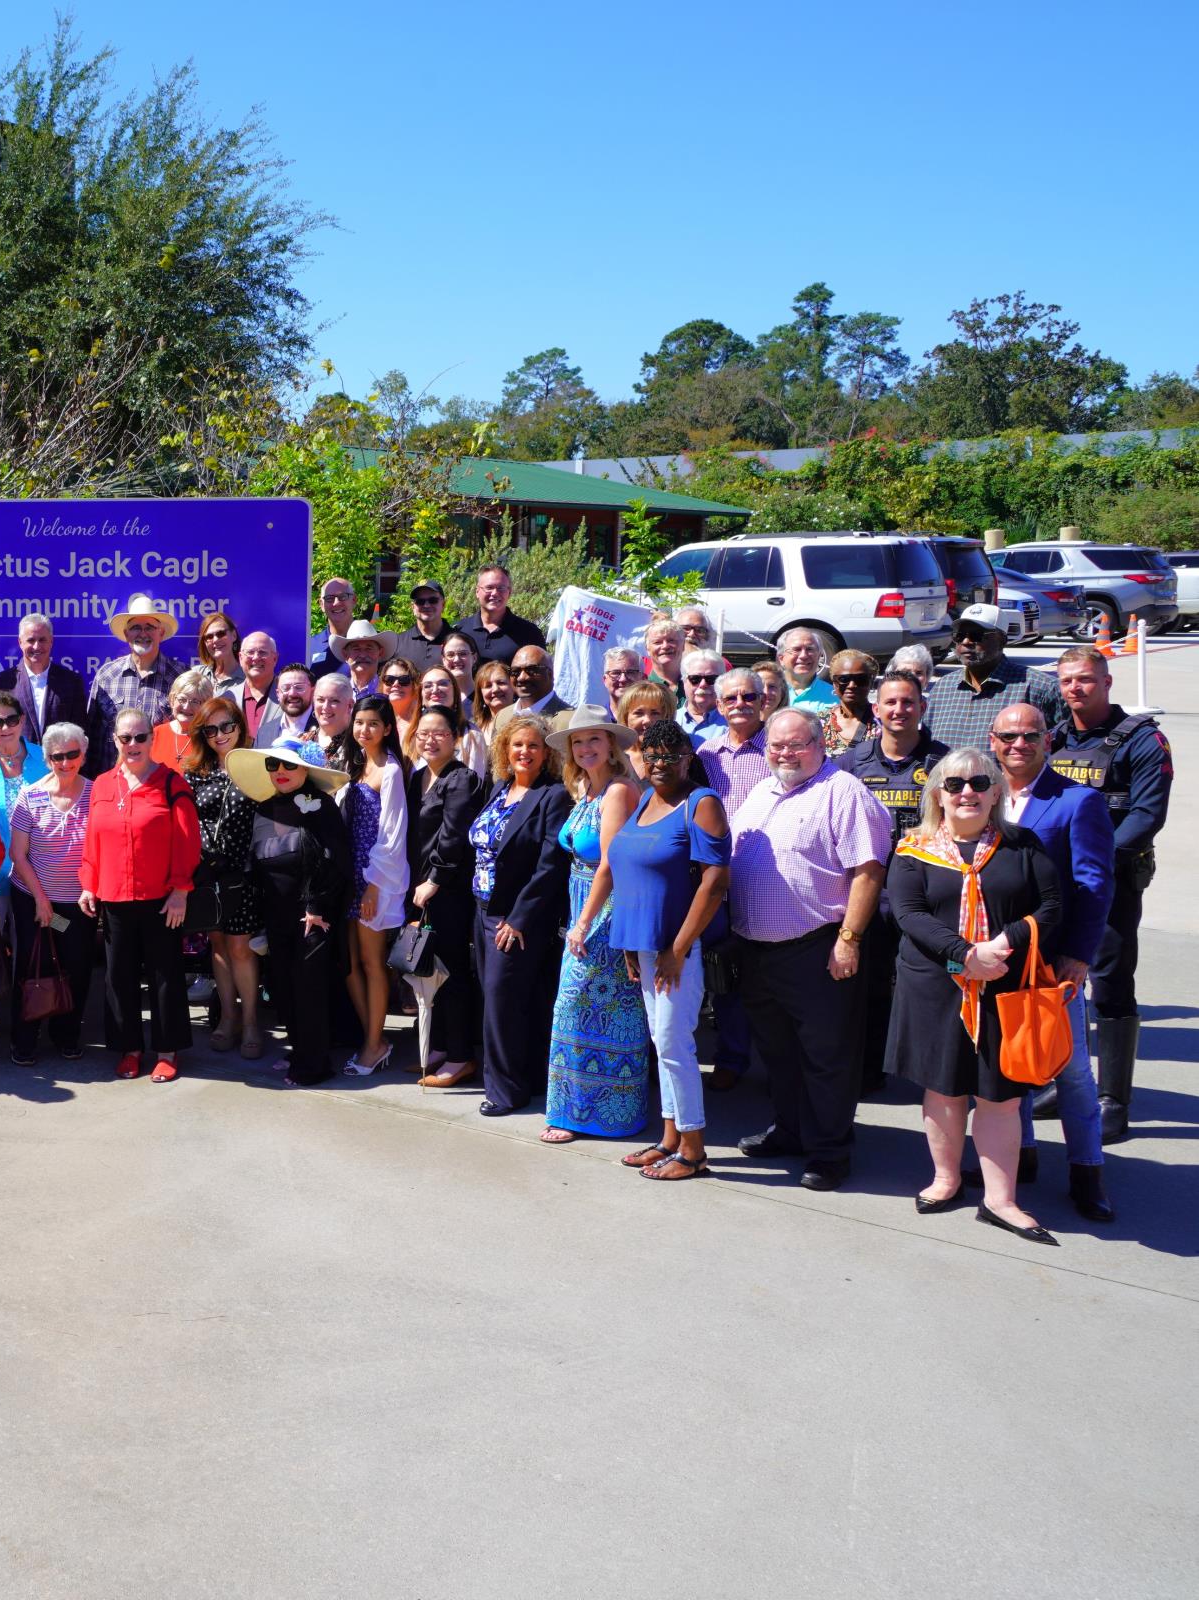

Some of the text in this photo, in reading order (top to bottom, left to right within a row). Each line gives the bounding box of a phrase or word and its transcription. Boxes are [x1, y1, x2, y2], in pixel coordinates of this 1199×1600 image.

[22, 516, 152, 538] Welcome to the
[59, 550, 132, 578] Jack
[140, 550, 229, 585] Cagle
[584, 604, 617, 622] JUDGE
[565, 619, 607, 642] CAGLE
[586, 617, 611, 632] JACK
